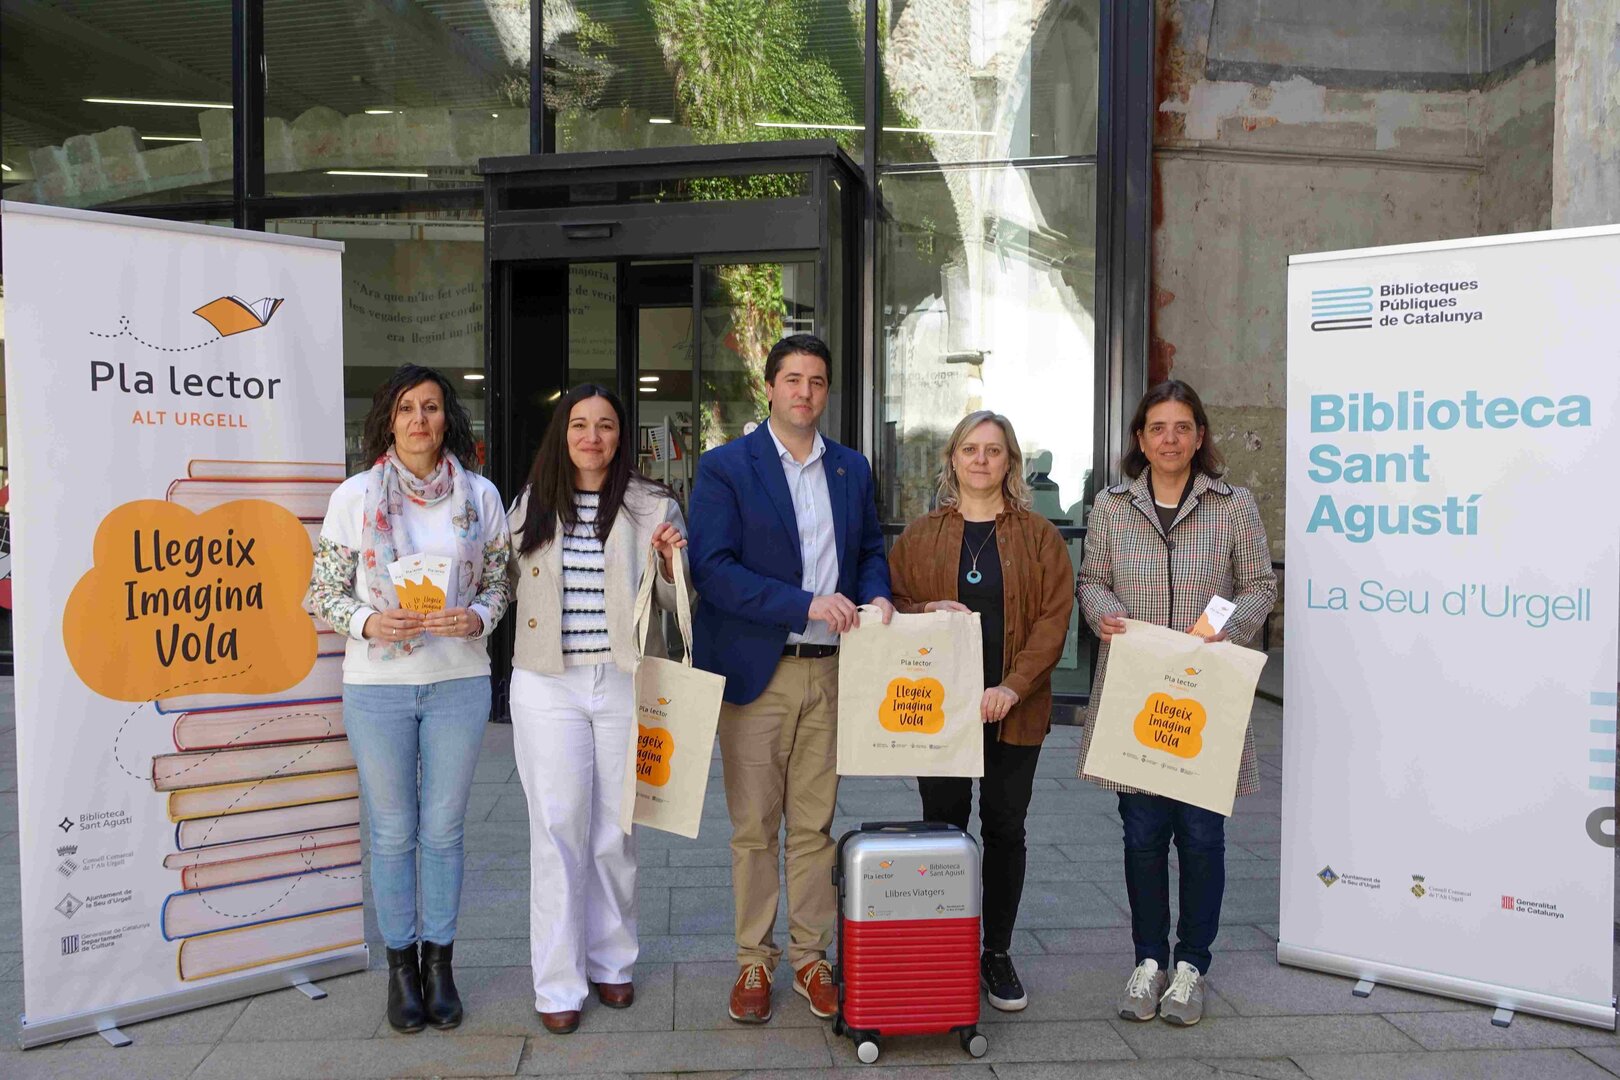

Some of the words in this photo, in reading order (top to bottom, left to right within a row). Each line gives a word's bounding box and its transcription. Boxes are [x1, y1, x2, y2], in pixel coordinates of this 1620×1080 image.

[575, 285, 588, 296] de
[1380, 279, 1478, 297] Biblioteques
[384, 293, 404, 303] que
[1380, 296, 1457, 312] Públiques
[349, 298, 365, 314] les
[368, 309, 413, 323] vegades
[416, 314, 436, 324] que
[439, 302, 483, 320] recordo
[1379, 314, 1398, 327] de
[1403, 310, 1483, 325] Catalunya
[386, 334, 405, 343] era
[90, 360, 154, 394] Pla
[170, 366, 282, 400] lector
[1310, 390, 1592, 433] Biblioteca
[132, 410, 166, 426] ALT
[175, 411, 248, 429] URGELL
[1307, 444, 1430, 484] Sant
[1306, 494, 1483, 543] Agustí
[134, 529, 256, 578] Llegeix
[124, 577, 264, 622] Imagina
[1307, 579, 1348, 610] La
[1359, 580, 1429, 614] Seu
[156, 623, 239, 668] Vola
[1164, 674, 1176, 682] Pla
[1177, 678, 1198, 688] lector
[896, 685, 932, 700] Llegeix
[650, 707, 668, 717] lector
[893, 699, 933, 713] Imagina
[1154, 700, 1193, 721] Llegeix
[900, 713, 924, 726] Vola
[1148, 714, 1191, 735] Imagina
[638, 735, 664, 749] egeix
[1154, 730, 1180, 748] Vola
[637, 749, 662, 763] agina
[636, 762, 652, 776] ola
[80, 810, 125, 822] Biblioteca
[80, 821, 101, 831] Sant
[103, 816, 133, 828] Agustí
[885, 889, 911, 898] Llibres
[912, 888, 945, 897] Viatgers
[1516, 898, 1557, 910] Generalitat
[1527, 907, 1564, 919] Catalunya
[81, 933, 123, 946] Departament
[91, 941, 115, 950] Cultura
